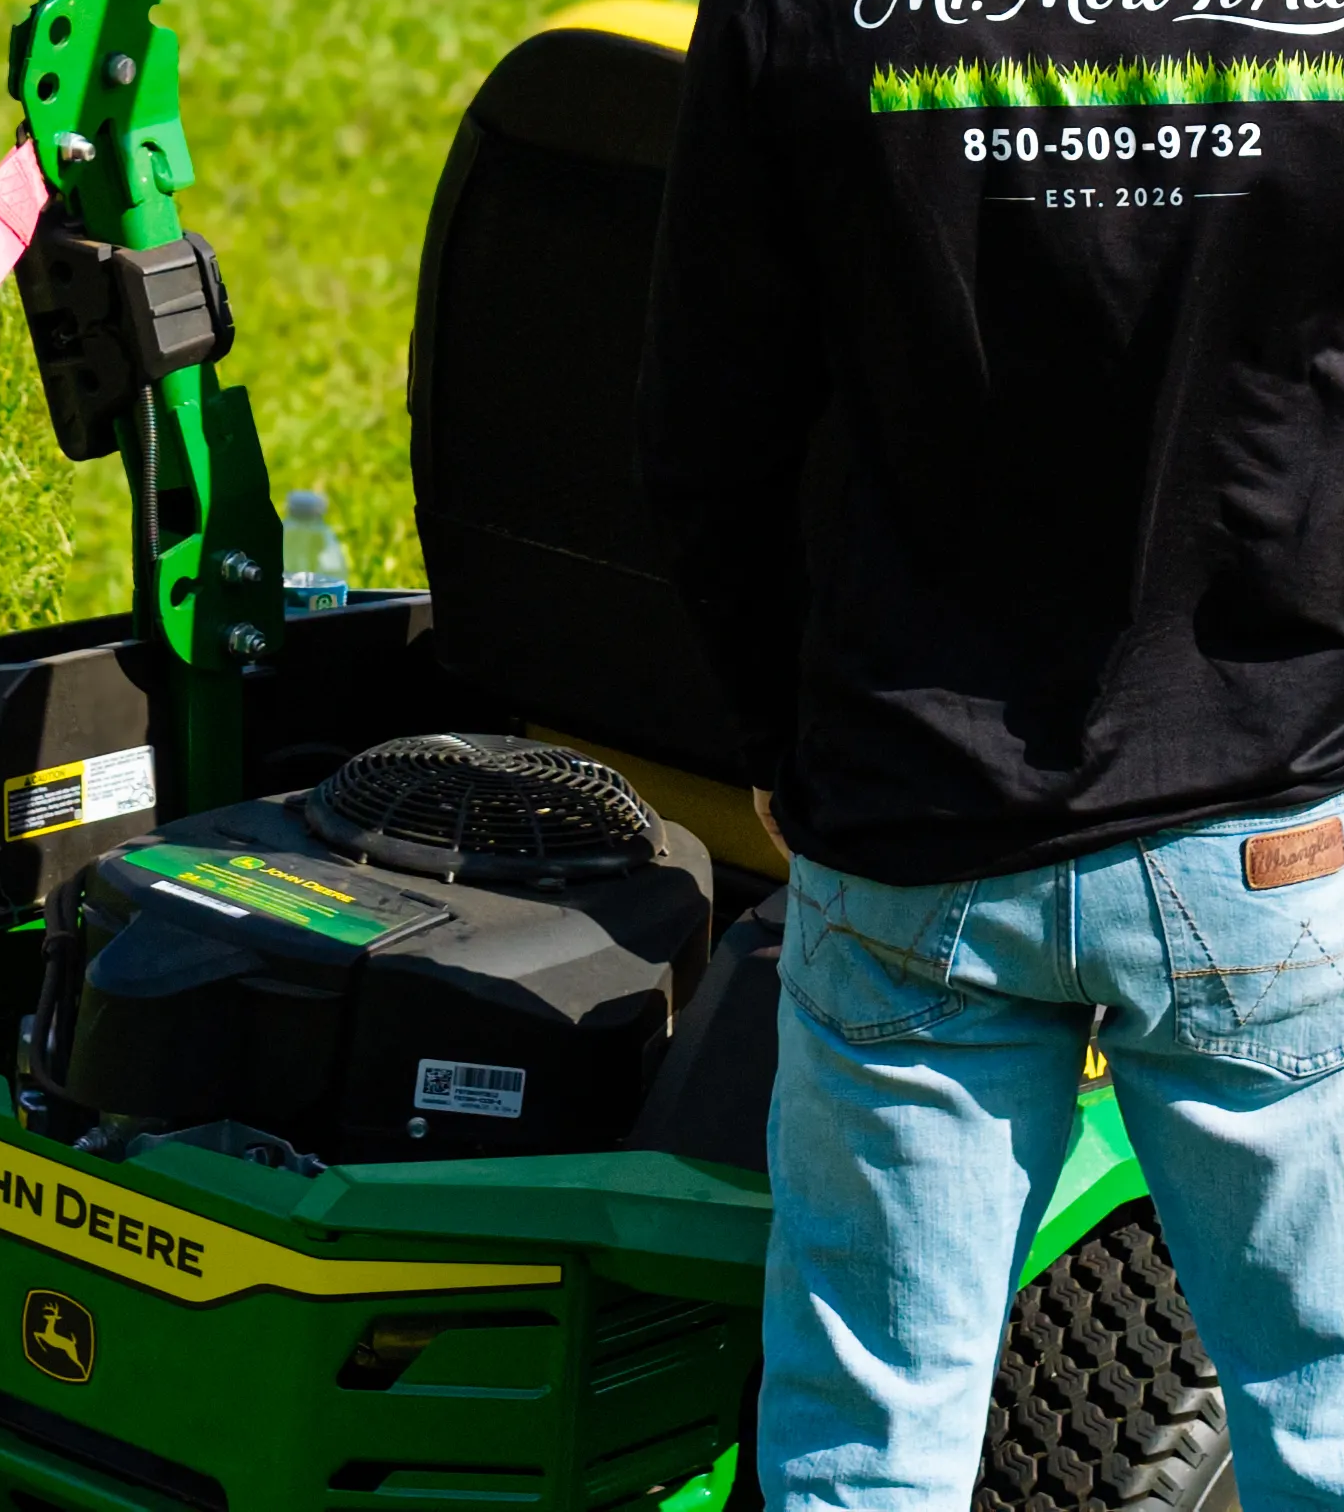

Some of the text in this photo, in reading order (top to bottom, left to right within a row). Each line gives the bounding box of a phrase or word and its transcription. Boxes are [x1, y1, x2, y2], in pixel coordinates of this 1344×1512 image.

[963, 122, 1262, 162] 850-509-9732
[1045, 186, 1183, 209] EST. 2026
[259, 867, 357, 903] JOHN DEERE
[54, 1182, 205, 1278] DEERE
